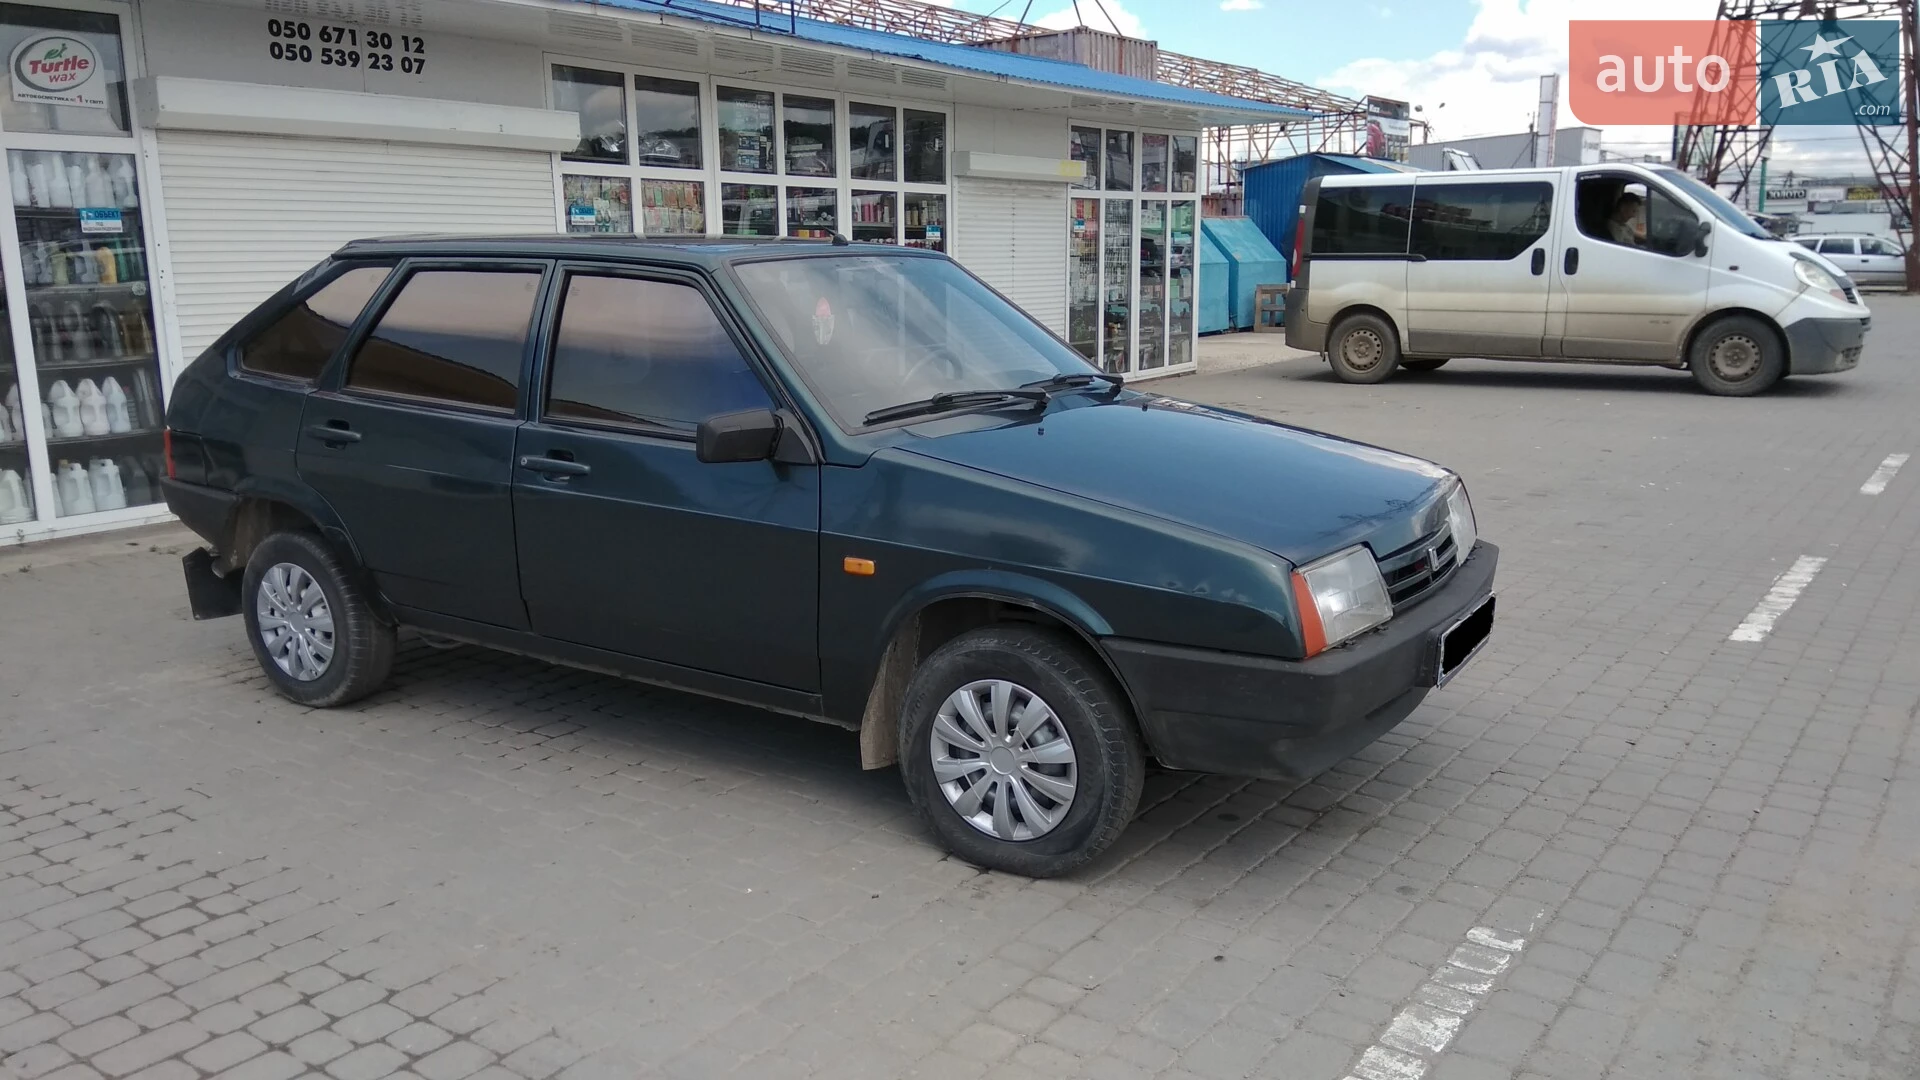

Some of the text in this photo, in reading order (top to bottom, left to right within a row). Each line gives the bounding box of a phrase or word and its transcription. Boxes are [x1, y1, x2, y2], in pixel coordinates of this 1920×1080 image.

[267, 18, 425, 54] 050 671 30 12
[29, 55, 89, 75] Turtle
[269, 41, 426, 75] 050 539 23 07
[49, 72, 77, 83] wax
